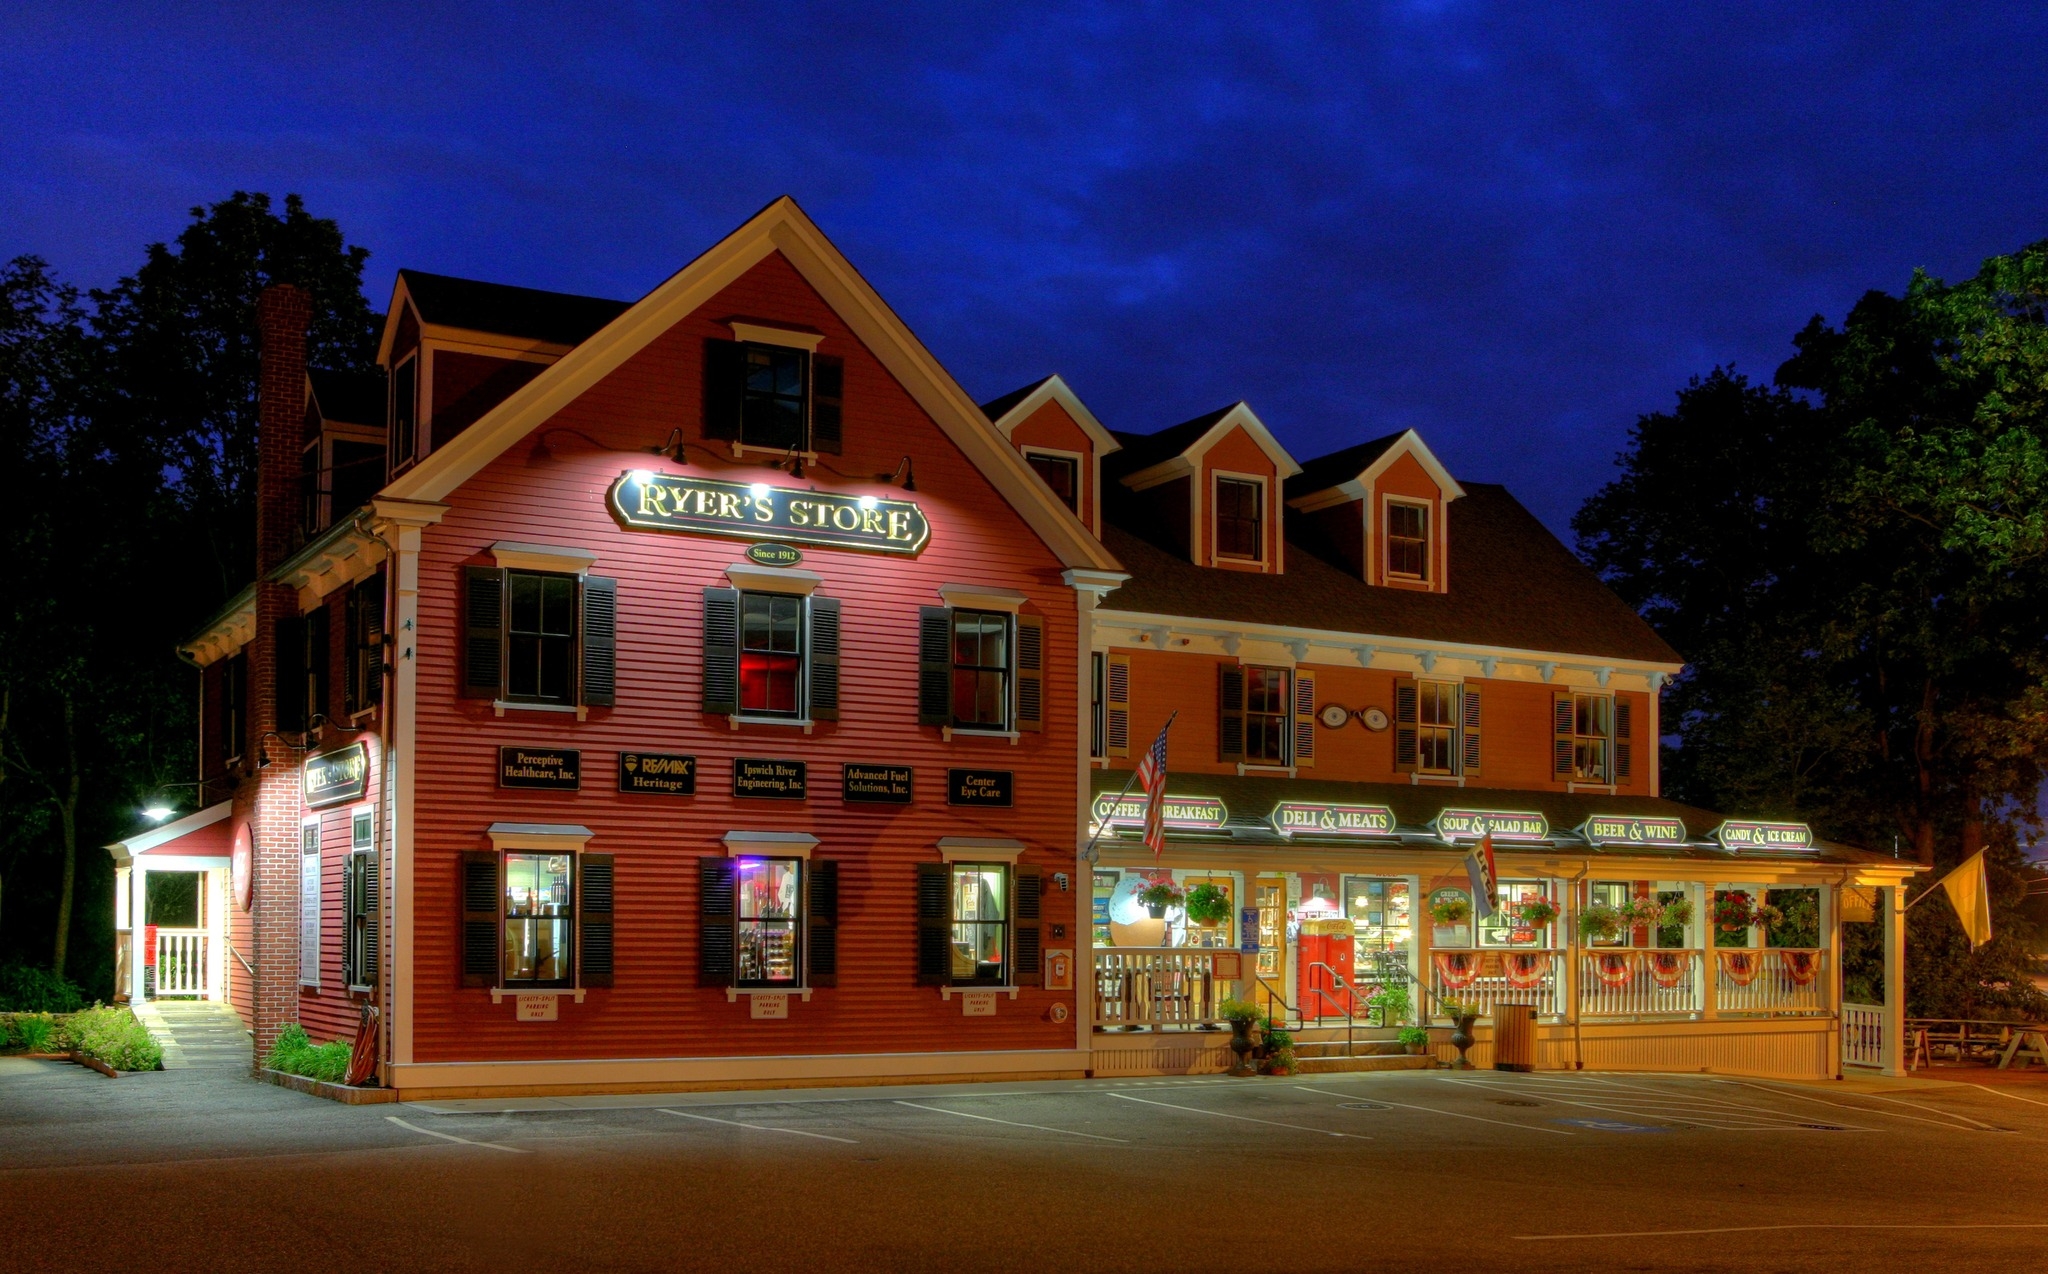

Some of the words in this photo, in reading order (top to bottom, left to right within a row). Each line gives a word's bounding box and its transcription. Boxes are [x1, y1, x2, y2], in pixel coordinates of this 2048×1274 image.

[637, 482, 774, 522] RYER'S
[790, 501, 912, 541] STORE
[753, 549, 776, 559] Since
[778, 550, 796, 560] 1912
[517, 752, 564, 768] Perceptive
[505, 765, 557, 780] Healthcare,
[559, 768, 576, 780] Inc.
[744, 763, 774, 777] Ipswich
[776, 765, 797, 776] River
[847, 768, 888, 780] Advanced
[890, 770, 908, 781] Fuel
[633, 777, 683, 791] Heritage
[737, 776, 787, 792] Engineering,
[789, 779, 804, 790] Inc.
[848, 781, 890, 794] Solutions,
[892, 783, 908, 794] Inc.
[966, 775, 996, 787] Center
[961, 785, 977, 799] Eye
[980, 787, 1001, 798] Care
[1100, 802, 1141, 817] COFFEE
[1283, 810, 1317, 826] DELI
[1320, 810, 1338, 830] &
[1338, 813, 1387, 828] MEATS
[1443, 818, 1469, 831] SOUP
[1471, 816, 1487, 835] &
[1488, 819, 1520, 833] SALAD
[1523, 821, 1542, 833] BAR
[1593, 823, 1626, 837] BEER
[1629, 822, 1644, 841] &
[1645, 825, 1678, 839] WINE
[1725, 829, 1751, 841] CANDY
[1753, 827, 1766, 845] &
[1767, 830, 1780, 842] ICE
[1781, 831, 1806, 843] CREAM
